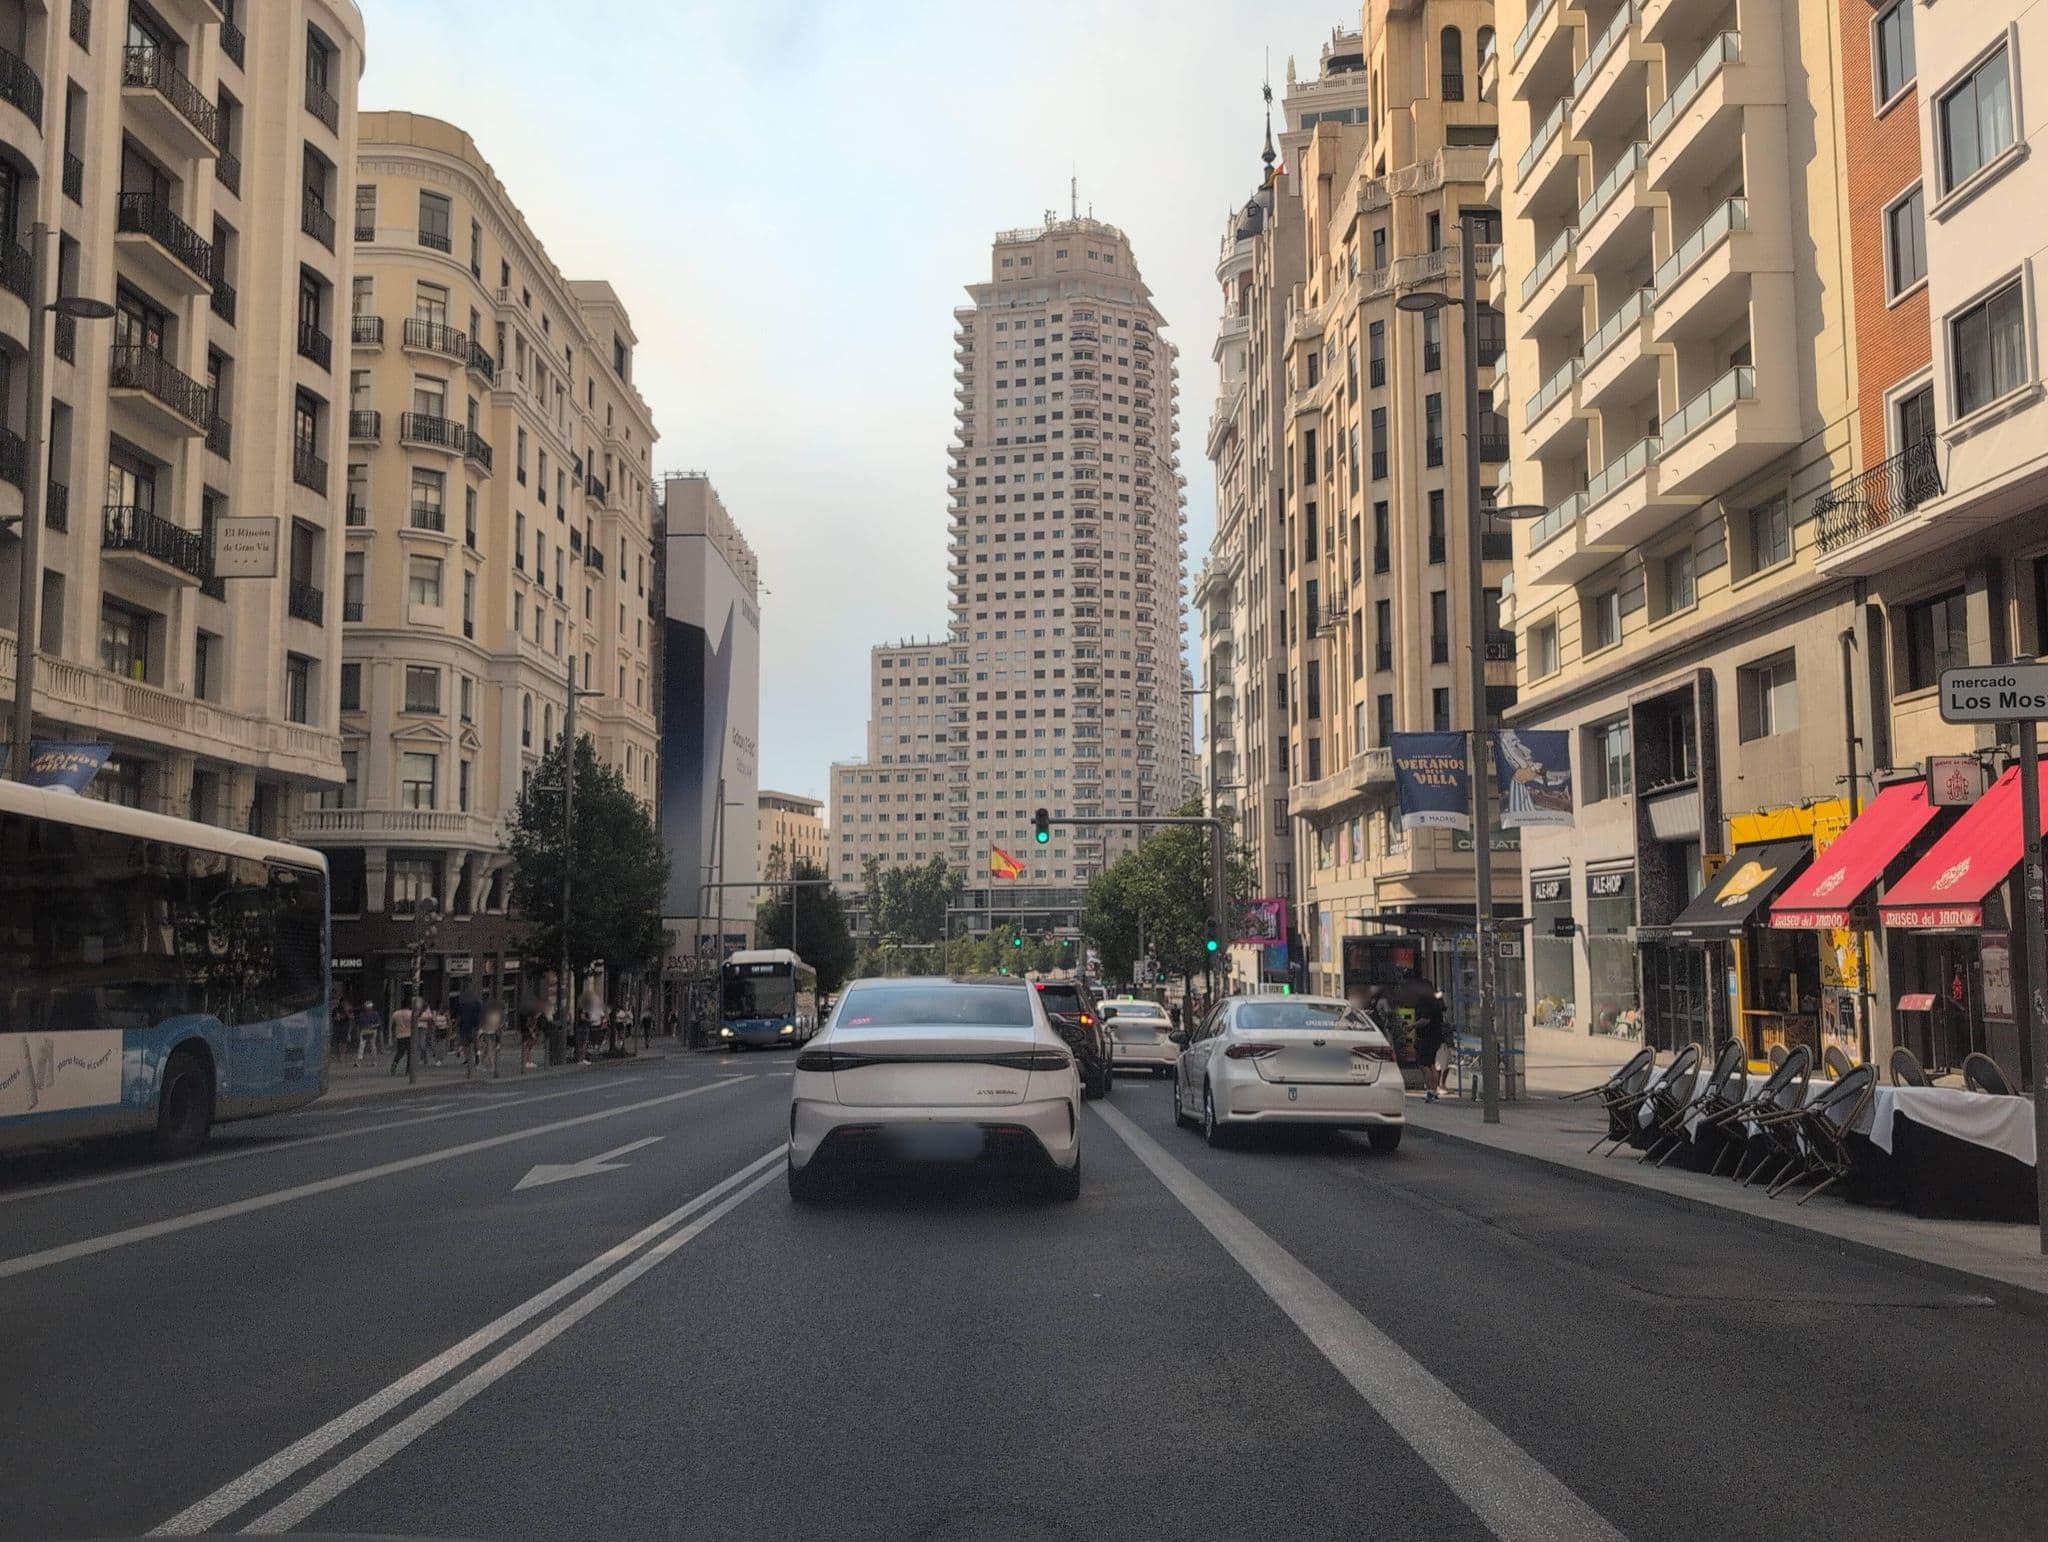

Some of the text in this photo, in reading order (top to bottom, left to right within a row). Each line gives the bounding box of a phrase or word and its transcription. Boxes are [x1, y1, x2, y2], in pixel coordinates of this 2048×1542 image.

[235, 543, 255, 551] Gran
[1952, 675, 2017, 689] mercado
[1951, 691, 2048, 710] Los Mos
[1396, 758, 1465, 770] VERANOS
[1413, 772, 1458, 786] VILLA
[1535, 881, 1560, 899] ALE-HOP
[1592, 874, 1622, 895] ALE-HOP
[1885, 912, 1918, 926] MUSEO
[1921, 911, 1935, 925] del
[339, 958, 363, 967] KING
